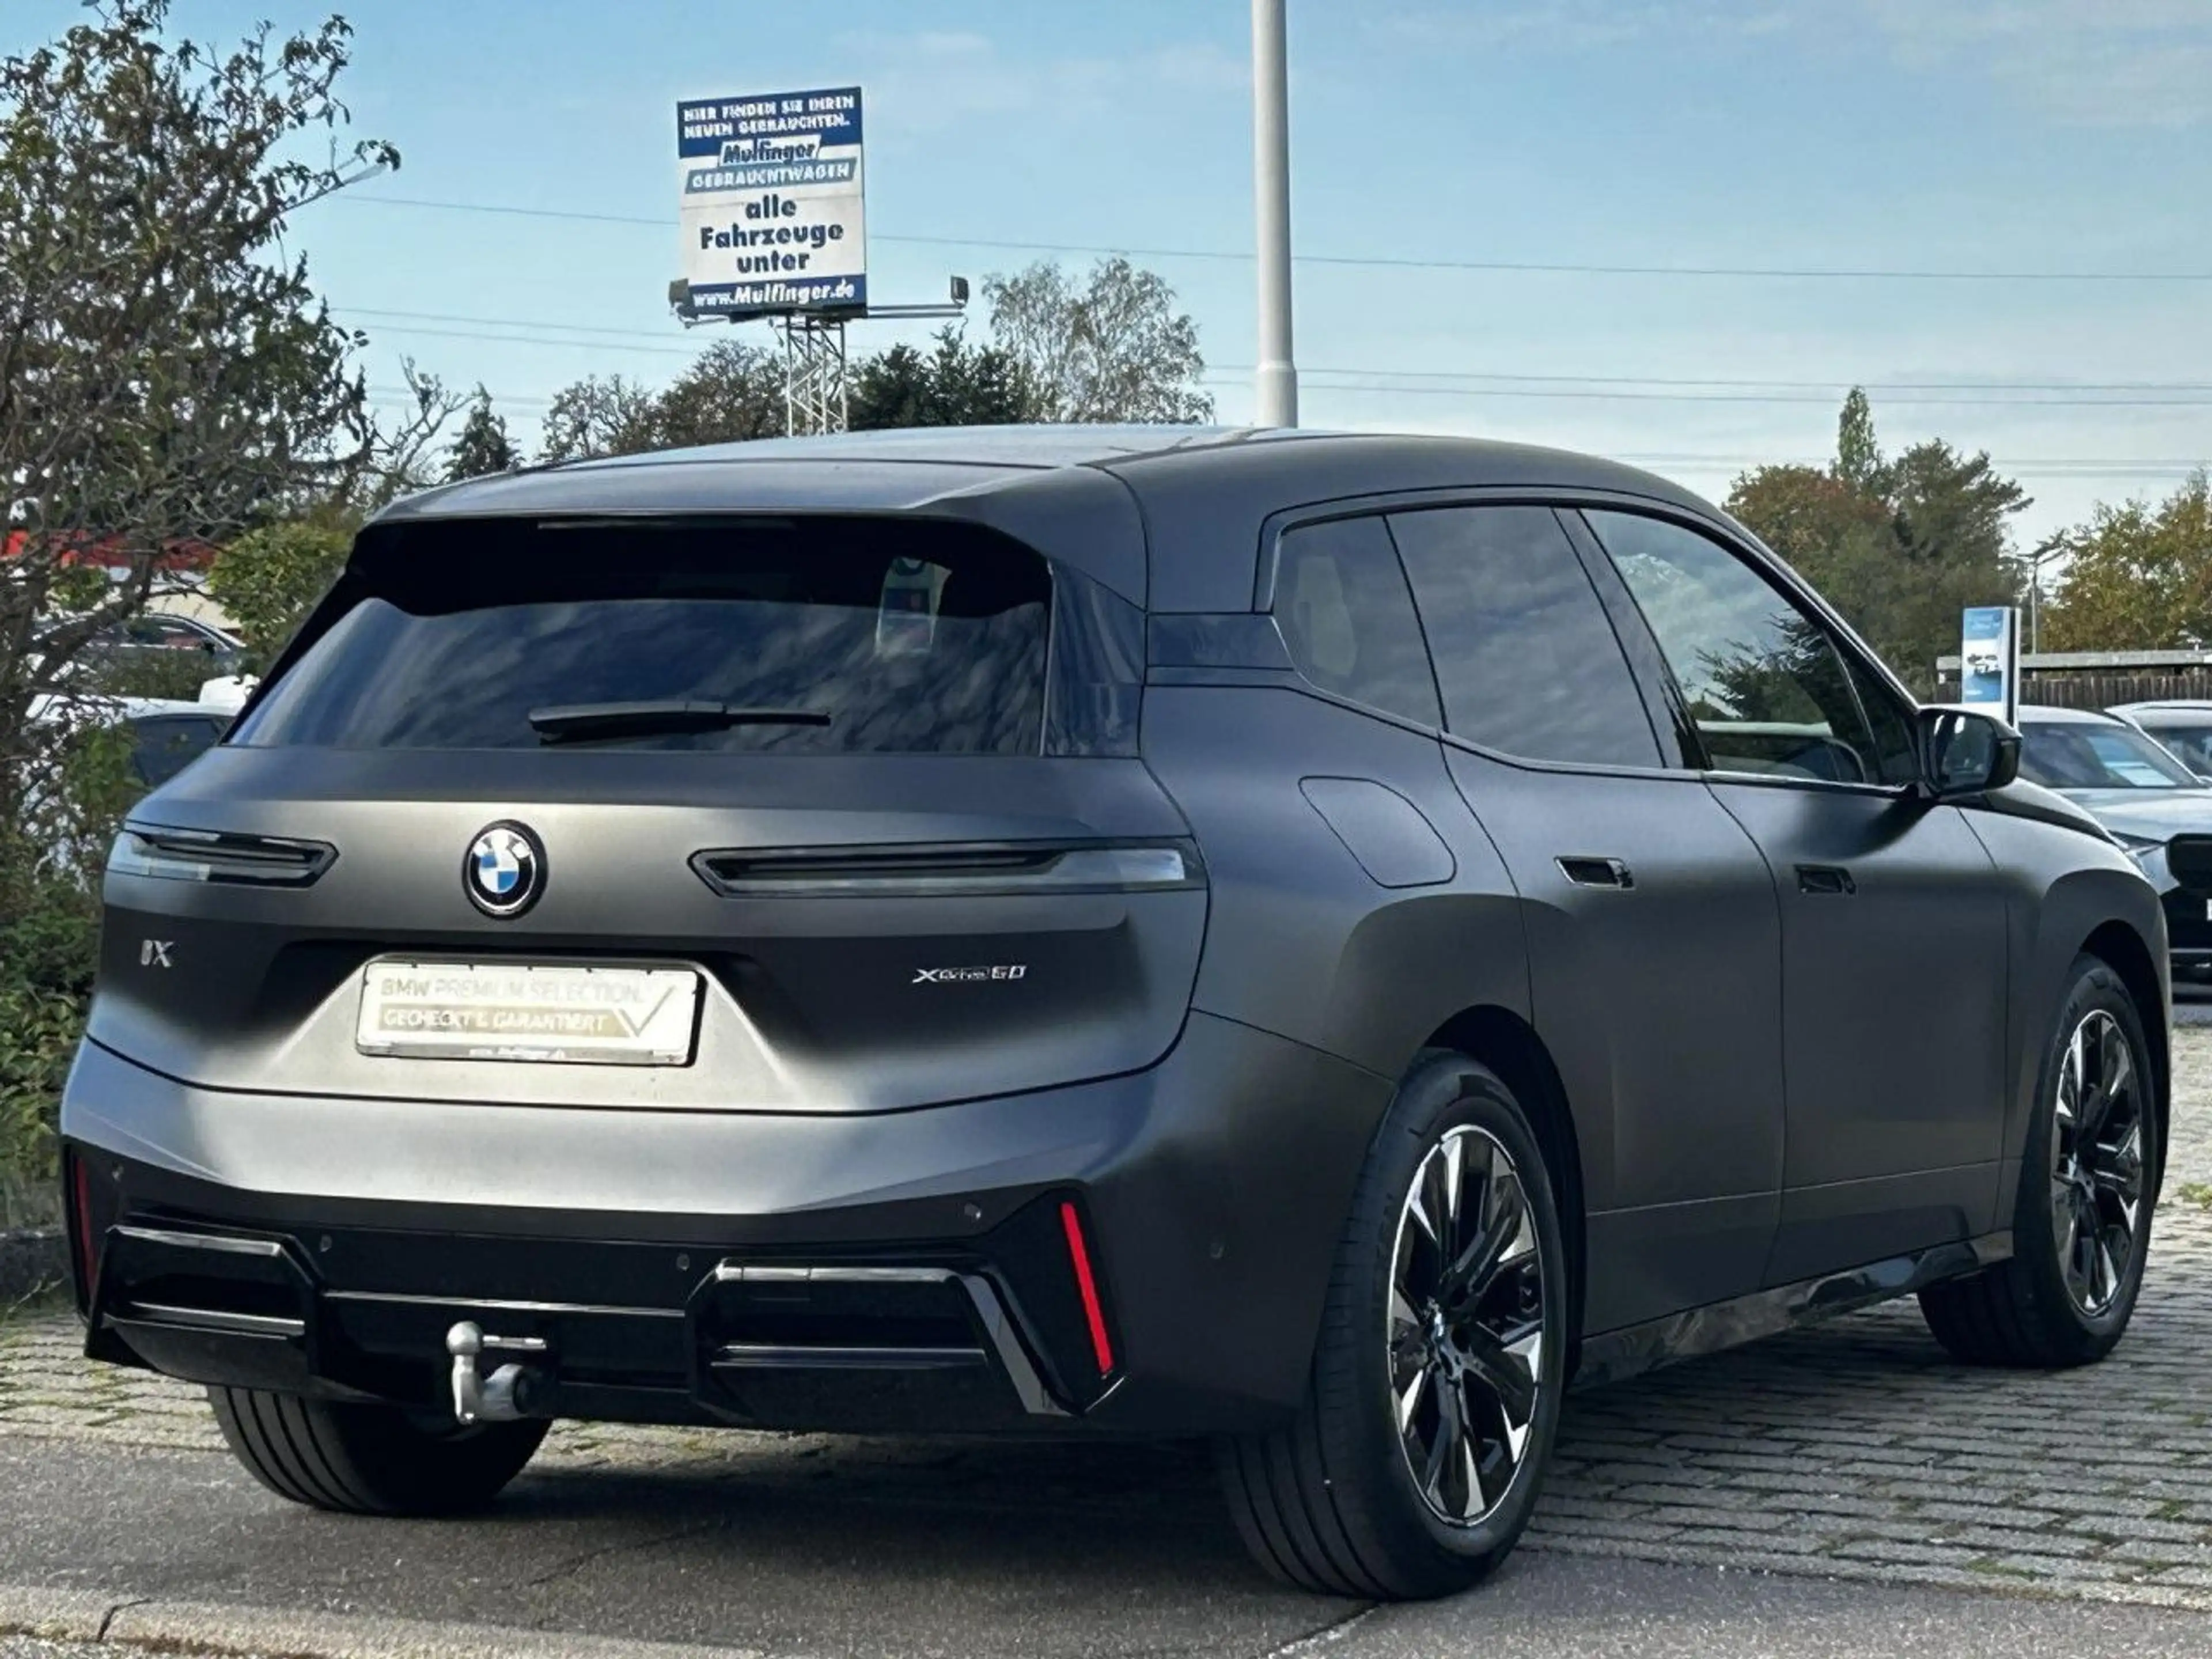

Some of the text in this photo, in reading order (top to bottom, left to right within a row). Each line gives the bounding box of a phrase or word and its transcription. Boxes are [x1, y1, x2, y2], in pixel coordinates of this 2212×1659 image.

[722, 101, 777, 119] FINDEN
[781, 99, 804, 114] SIE
[808, 96, 854, 112] IHREN
[684, 122, 733, 139] NEUEN
[692, 162, 850, 188] GEBRAUCHTWAGEN
[745, 194, 797, 219] alle
[700, 223, 844, 249] Fahrzeuge
[737, 250, 810, 274] unter
[692, 278, 855, 307] www.Mulfinger.de
[380, 977, 430, 997] BMW
